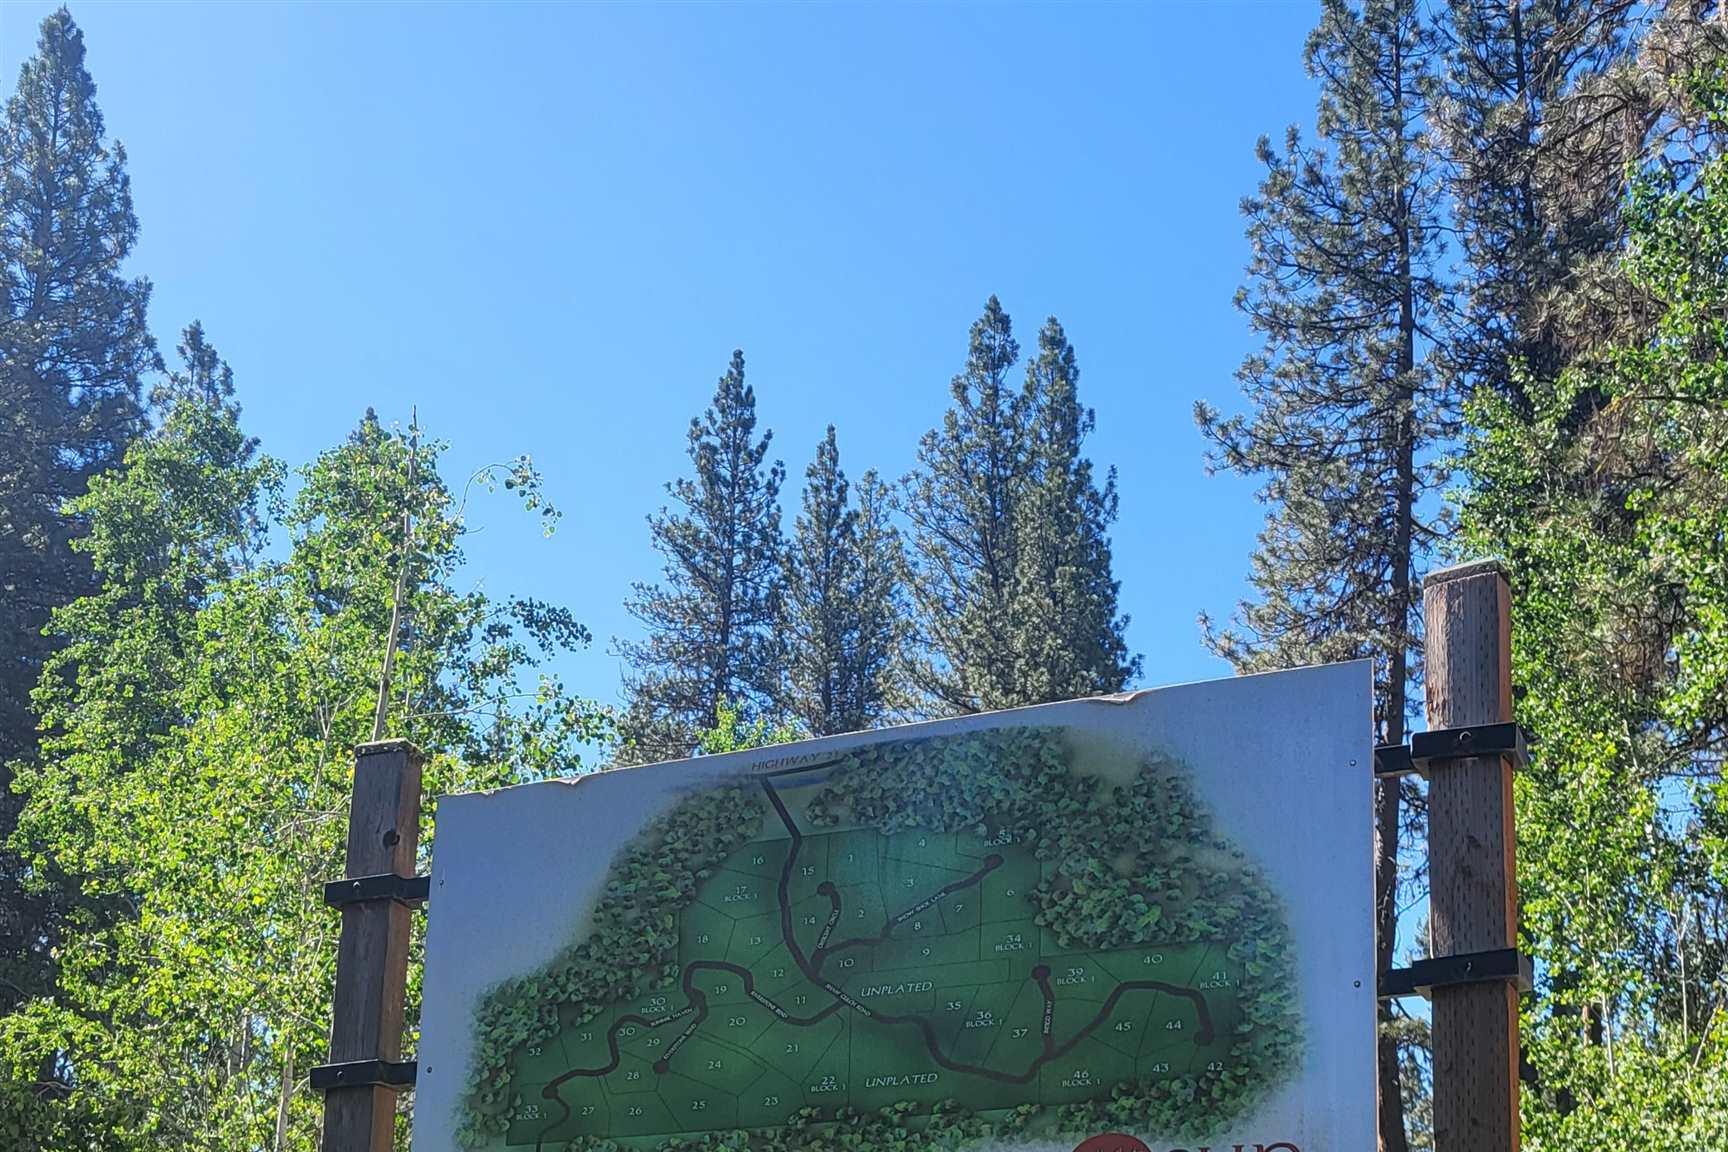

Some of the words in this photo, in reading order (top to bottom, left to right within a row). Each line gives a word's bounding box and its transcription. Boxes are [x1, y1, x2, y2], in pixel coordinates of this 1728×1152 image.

[752, 753, 818, 770] HIGHWAY
[753, 857, 764, 865] 16
[803, 868, 814, 878] 15
[736, 886, 747, 894] 17
[857, 909, 865, 918] 2
[804, 916, 816, 925] 14
[914, 921, 921, 930] 8
[922, 949, 930, 957] 9
[839, 958, 855, 968] 10
[1143, 954, 1163, 964] 40
[772, 969, 784, 977] 12
[1057, 976, 1086, 985] BLOCK
[715, 985, 727, 994] 19
[861, 982, 933, 997] UNPLATED
[650, 997, 666, 1006] 30
[796, 996, 806, 1004] 11
[641, 1006, 666, 1014] BLOCK
[947, 1002, 961, 1010] 35
[977, 1011, 992, 1020] 36
[729, 1017, 746, 1026] 20
[966, 1020, 994, 1028] BLOCK
[1115, 1021, 1131, 1031] 45
[1166, 1020, 1182, 1030] 44
[618, 1027, 636, 1036] 30
[1012, 1029, 1028, 1038] 37
[581, 1033, 593, 1041] 31
[647, 1039, 660, 1047] 29
[529, 1048, 542, 1056] 32
[786, 1044, 799, 1053] 21
[708, 1060, 721, 1069] 24
[1153, 1063, 1169, 1072] 43
[1207, 1062, 1224, 1071] 42
[627, 1072, 639, 1080] 28
[1073, 1070, 1089, 1079] 46
[822, 1076, 835, 1085] 22
[866, 1073, 938, 1088] UNPLATED
[1062, 1079, 1091, 1087] BLOCK
[811, 1084, 838, 1092] BLOCK
[692, 1101, 705, 1110] 25
[764, 1097, 779, 1106] 23
[582, 1107, 595, 1116] 27
[629, 1107, 642, 1116] 26
